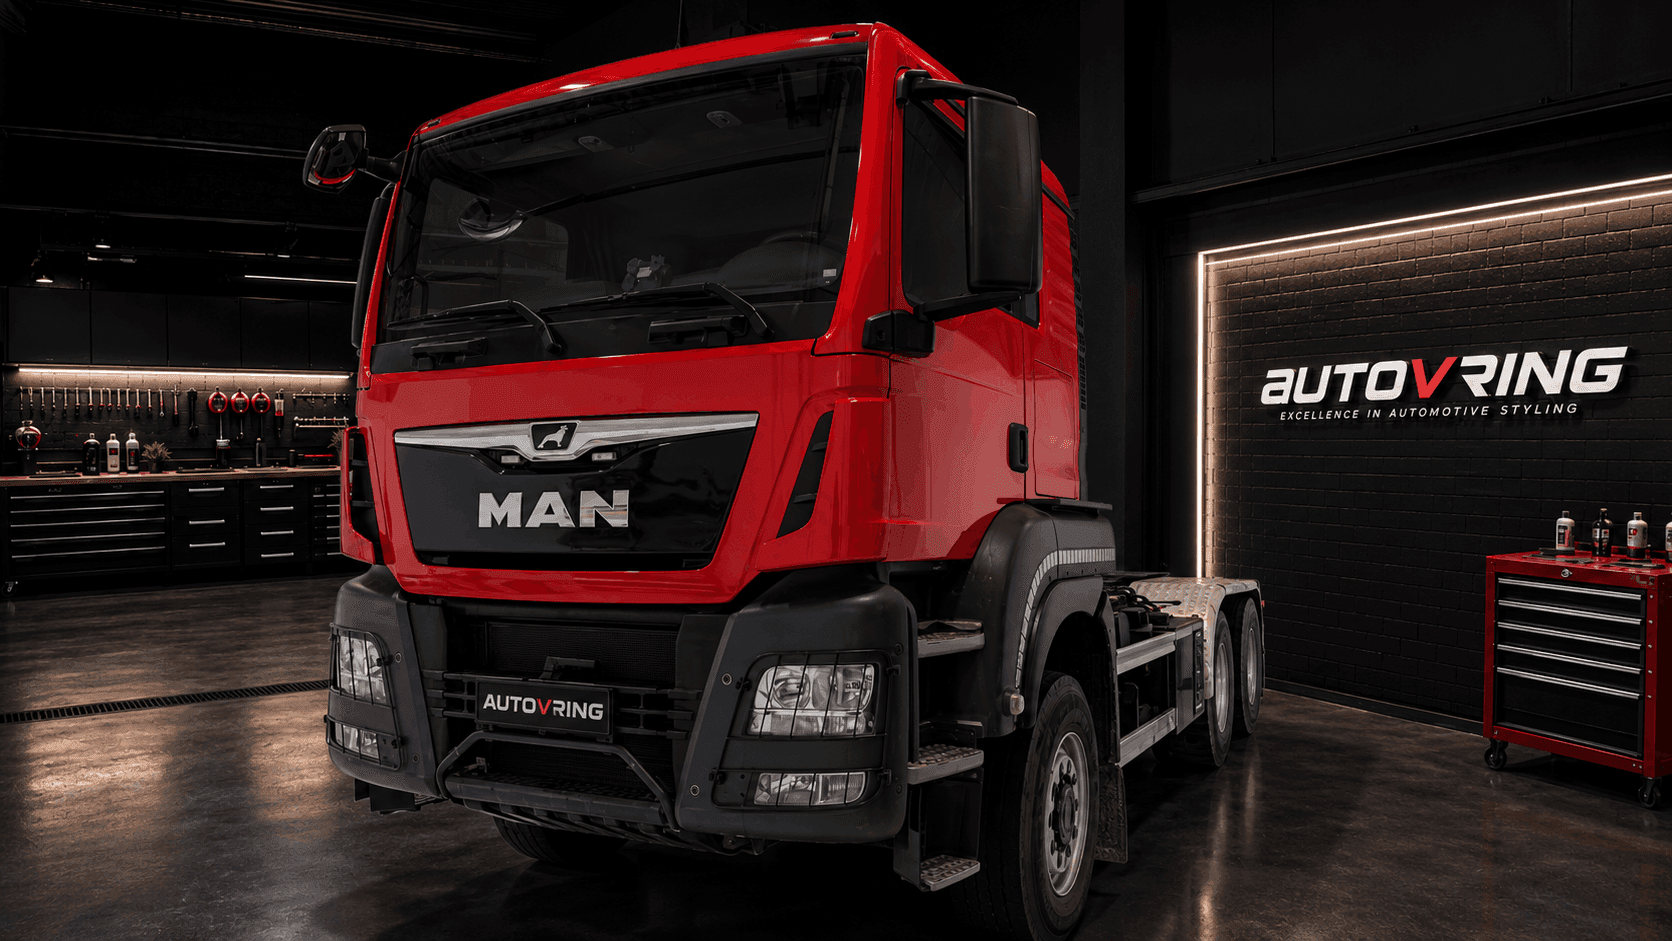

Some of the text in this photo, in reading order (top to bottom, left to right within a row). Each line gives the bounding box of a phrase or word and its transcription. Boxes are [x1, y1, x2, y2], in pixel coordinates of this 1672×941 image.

[1280, 402, 1578, 421] EXCELLENCE IN AUTOMOTIVE STYLING
[478, 489, 630, 528] MAN
[482, 693, 604, 721] AUTOVRING
